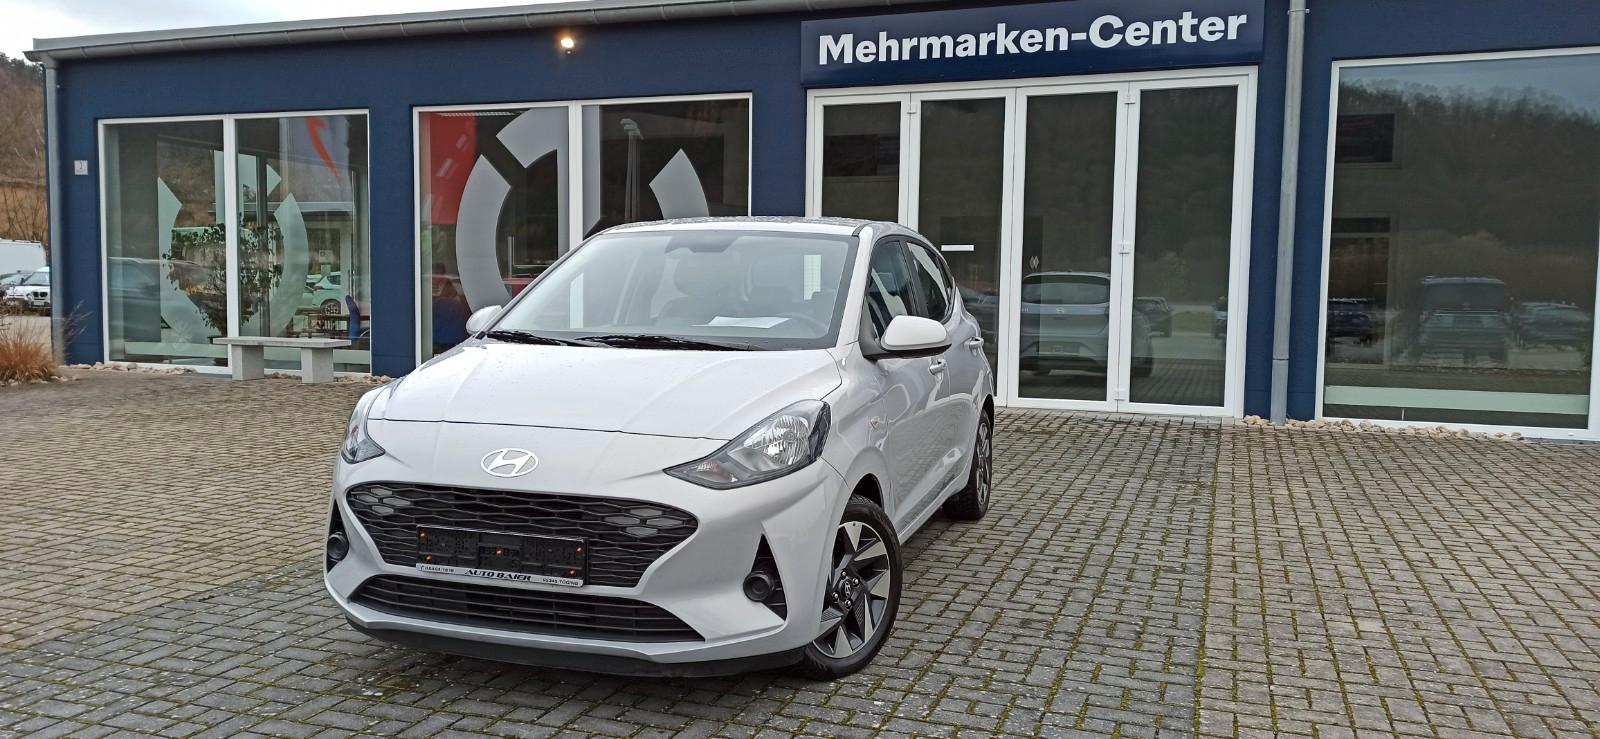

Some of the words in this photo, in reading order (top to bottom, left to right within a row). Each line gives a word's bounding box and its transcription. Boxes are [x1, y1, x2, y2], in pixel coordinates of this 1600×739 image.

[819, 11, 1247, 65] Mehrmarken-Center
[464, 569, 495, 578] AUTO
[497, 572, 532, 581] BAIER
